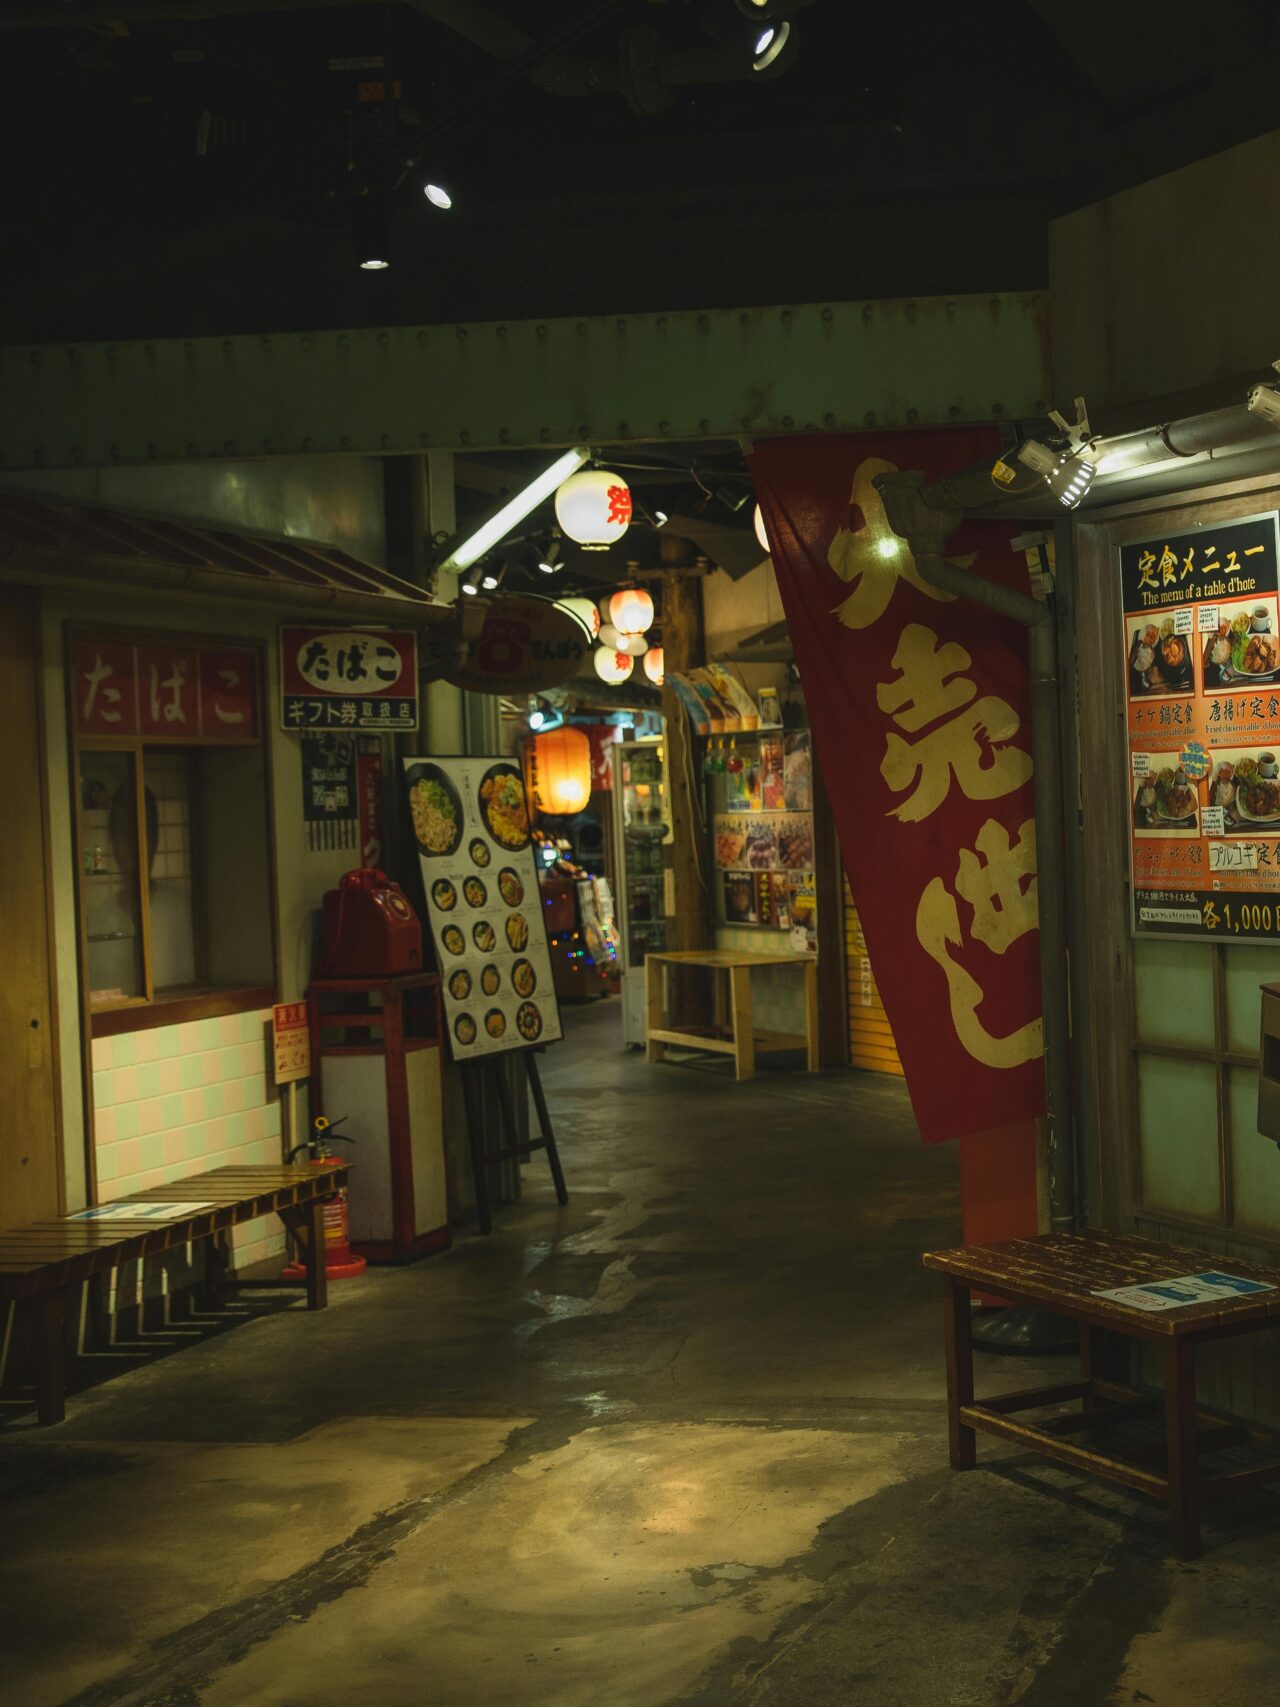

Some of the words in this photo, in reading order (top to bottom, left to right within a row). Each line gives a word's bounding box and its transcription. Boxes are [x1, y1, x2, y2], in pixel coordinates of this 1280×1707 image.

[1137, 545, 1265, 589] 定食メニュー
[1141, 591, 1159, 606] The
[1160, 589, 1184, 604] menu
[1185, 585, 1194, 600] of
[1195, 587, 1202, 598] a
[1204, 581, 1226, 596] table
[302, 641, 398, 682] たばこ
[83, 653, 246, 724] たばこ
[288, 700, 358, 725] ギフト券
[1208, 694, 1280, 722] 唐揚げ定食
